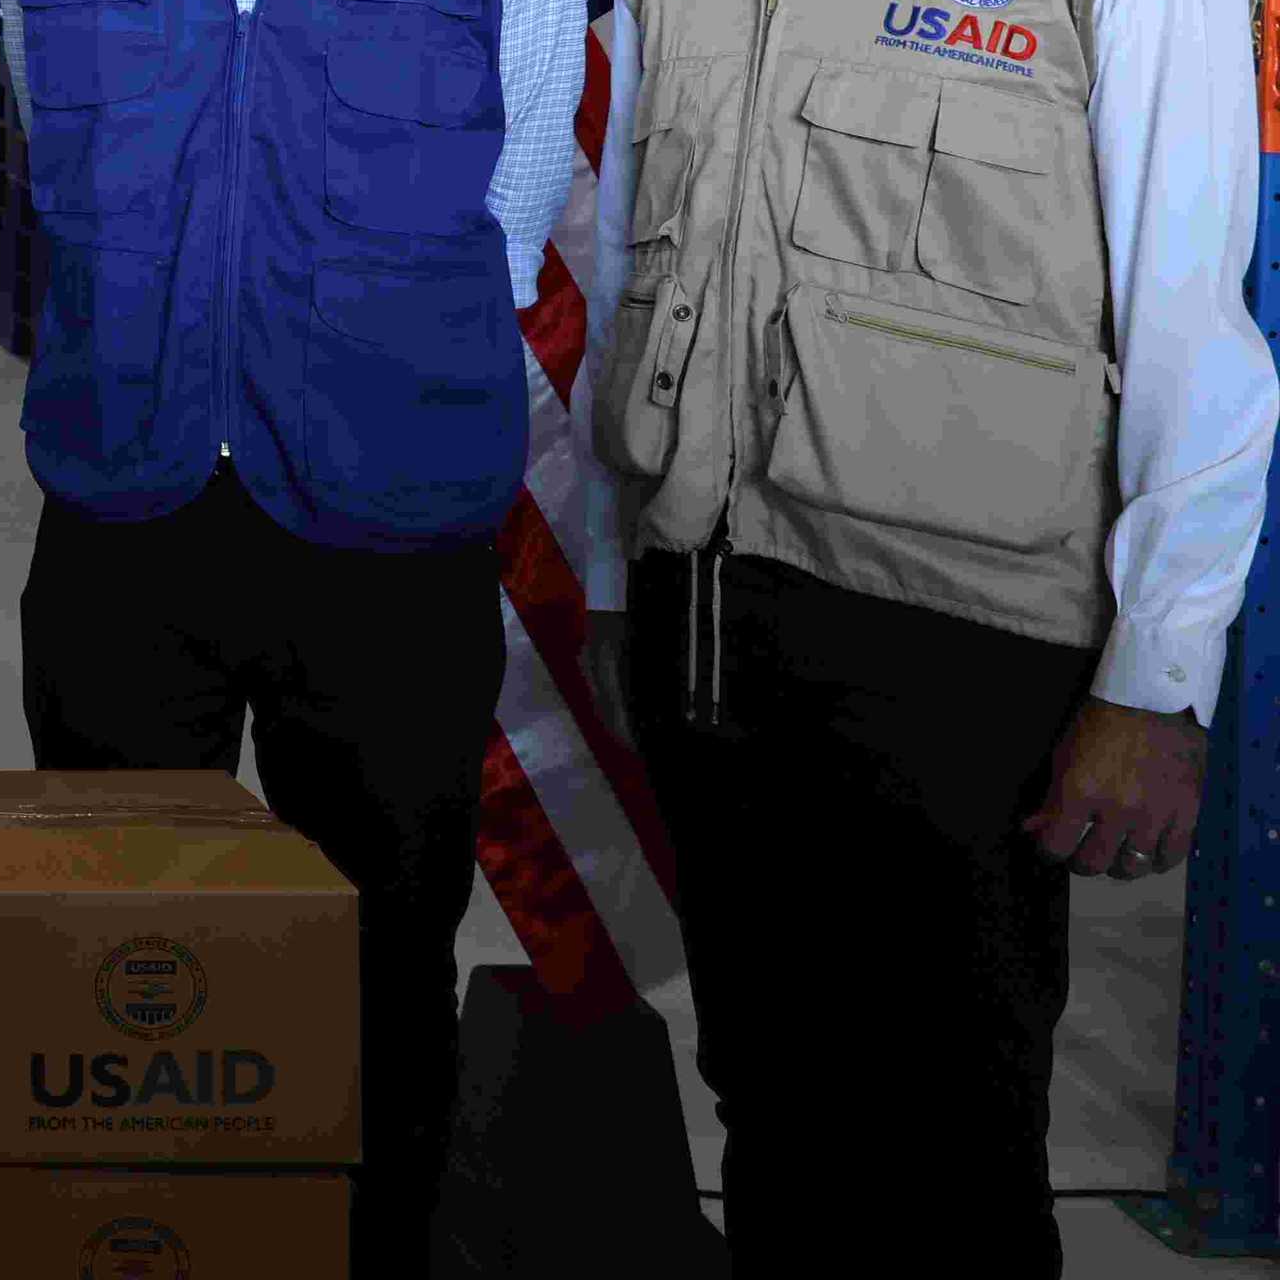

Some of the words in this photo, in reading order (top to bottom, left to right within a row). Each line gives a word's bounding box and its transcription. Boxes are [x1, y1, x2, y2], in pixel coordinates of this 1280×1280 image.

[874, 35, 907, 51] FROM
[909, 41, 932, 55] THE
[932, 44, 995, 70] AMERICAN
[996, 60, 1034, 78] PEOPLE
[883, 1, 1037, 62] USAID
[30, 1049, 275, 1107] USAID
[28, 1116, 76, 1132] FROM
[83, 1116, 113, 1132] THE
[119, 1116, 208, 1132] AMERICAN
[213, 1116, 275, 1132] PEOPLE
